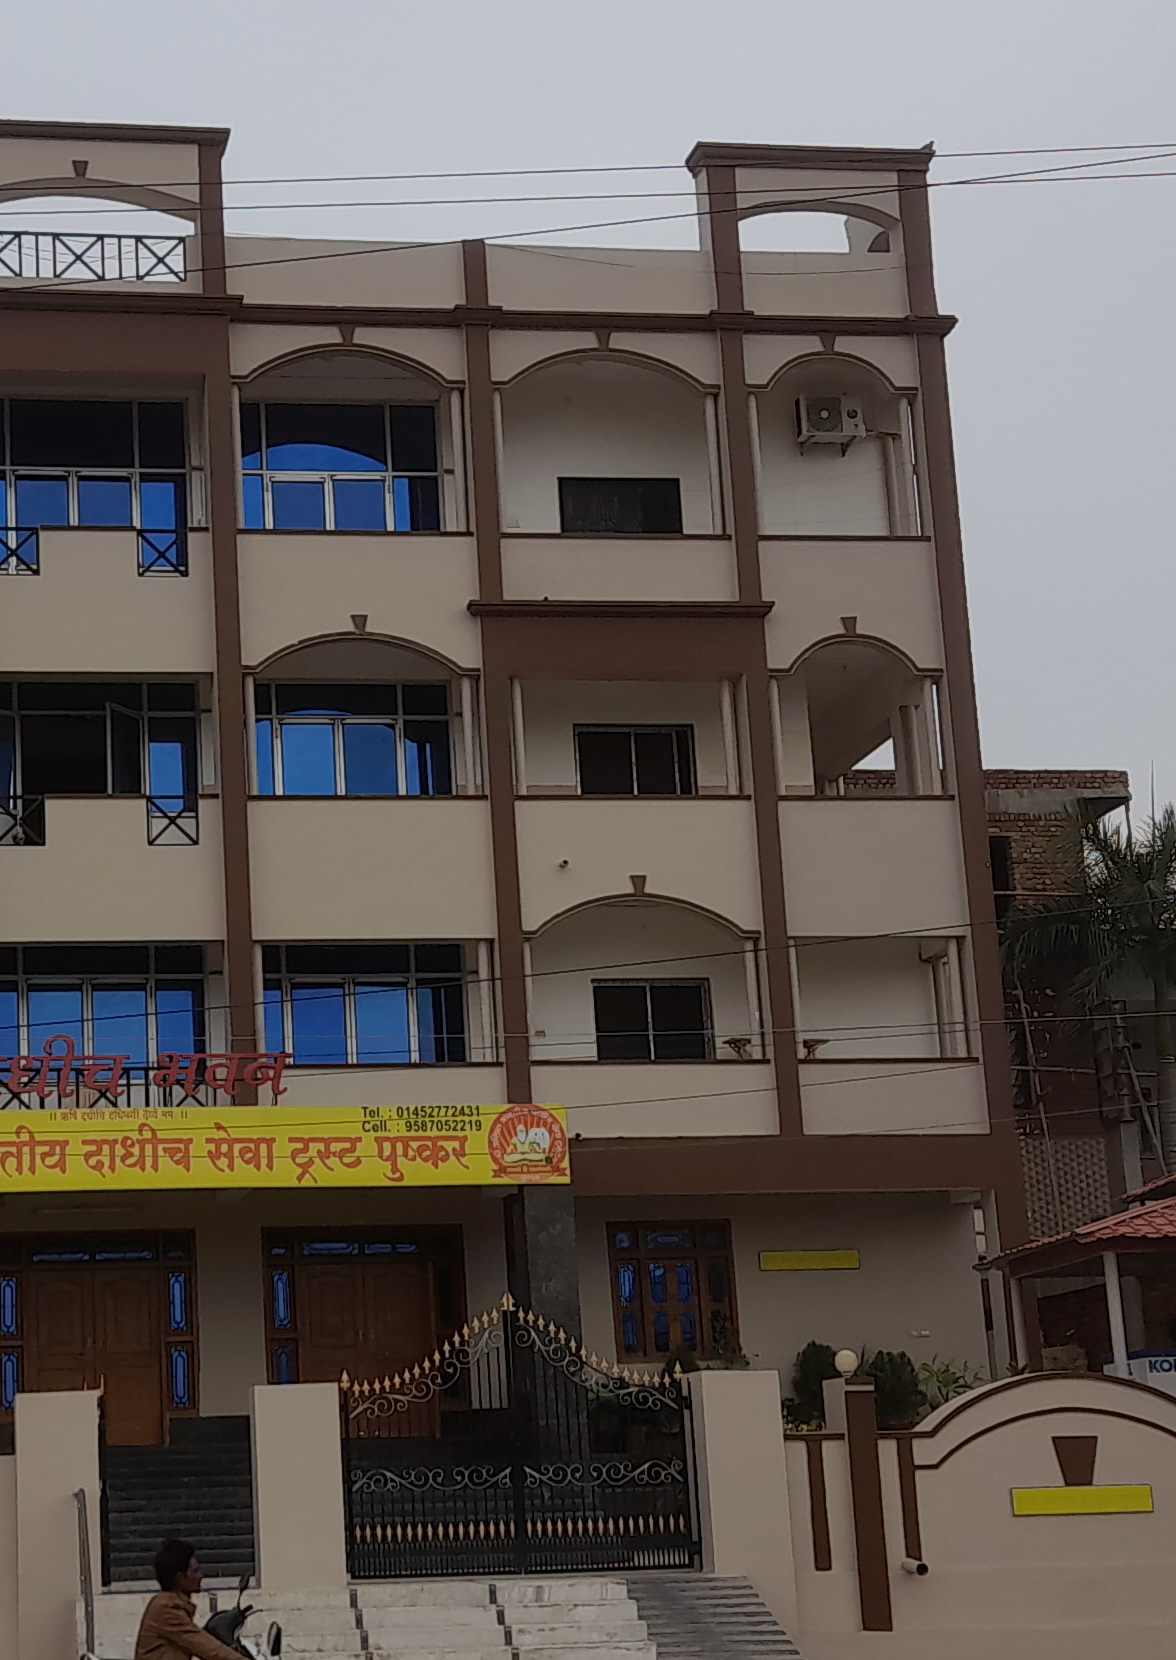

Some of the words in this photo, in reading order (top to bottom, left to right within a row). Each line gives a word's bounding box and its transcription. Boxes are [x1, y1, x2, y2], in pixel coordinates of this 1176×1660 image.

[153, 1052, 292, 1096] भवन
[361, 1106, 384, 1119] Tel.
[396, 1105, 481, 1118] 01452772431
[361, 1120, 391, 1133] Cell.
[405, 1120, 482, 1132] 9587052219
[81, 1122, 194, 1179] दाधीच
[205, 1122, 277, 1173] सेवा
[288, 1136, 362, 1184] ट्रस्ट
[375, 1135, 470, 1182] पुष्कर
[1148, 1358, 1176, 1374] KO
